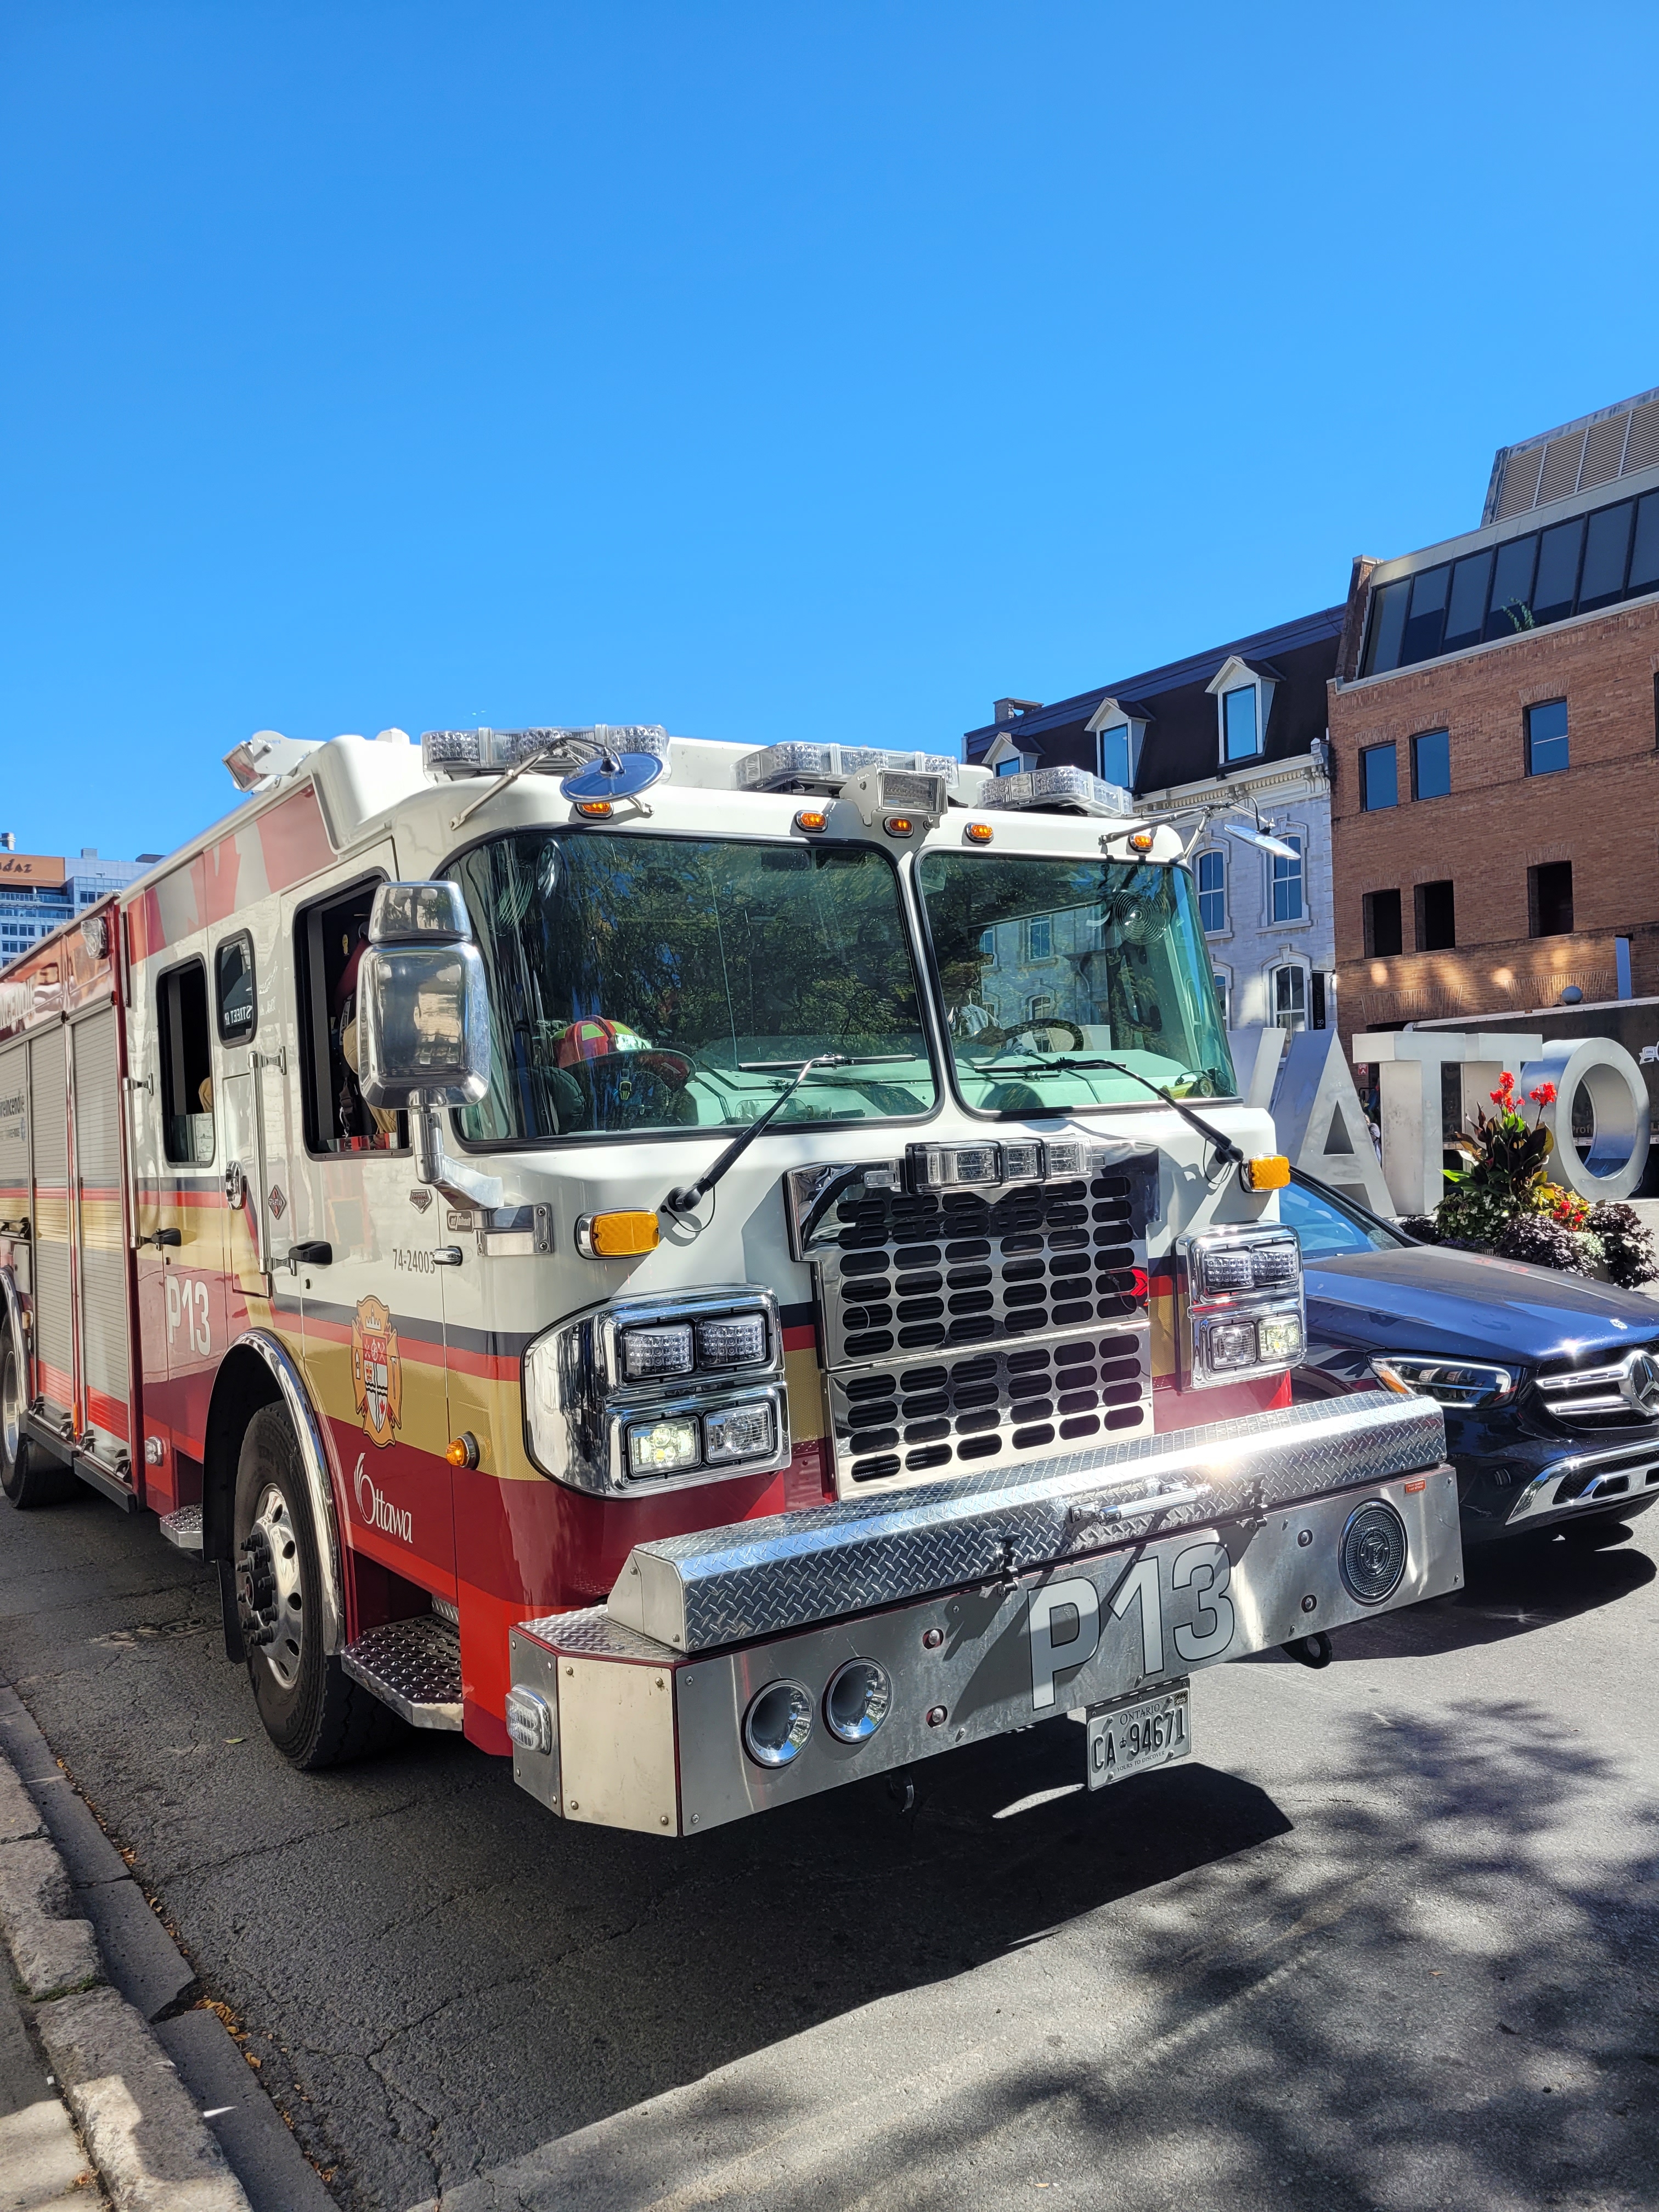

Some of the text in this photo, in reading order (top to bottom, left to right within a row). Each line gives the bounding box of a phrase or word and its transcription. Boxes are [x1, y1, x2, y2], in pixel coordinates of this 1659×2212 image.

[0, 858, 32, 873] daz
[166, 1274, 211, 1356] P13
[354, 1453, 413, 1544] Ottawa
[1028, 1542, 1235, 1712] P13
[1093, 1706, 1186, 1770] CA 94671
[1120, 1703, 1160, 1725] ONTARIO
[1116, 1762, 1133, 1772] YOURS
[1142, 1751, 1165, 1763] DISCOVER
